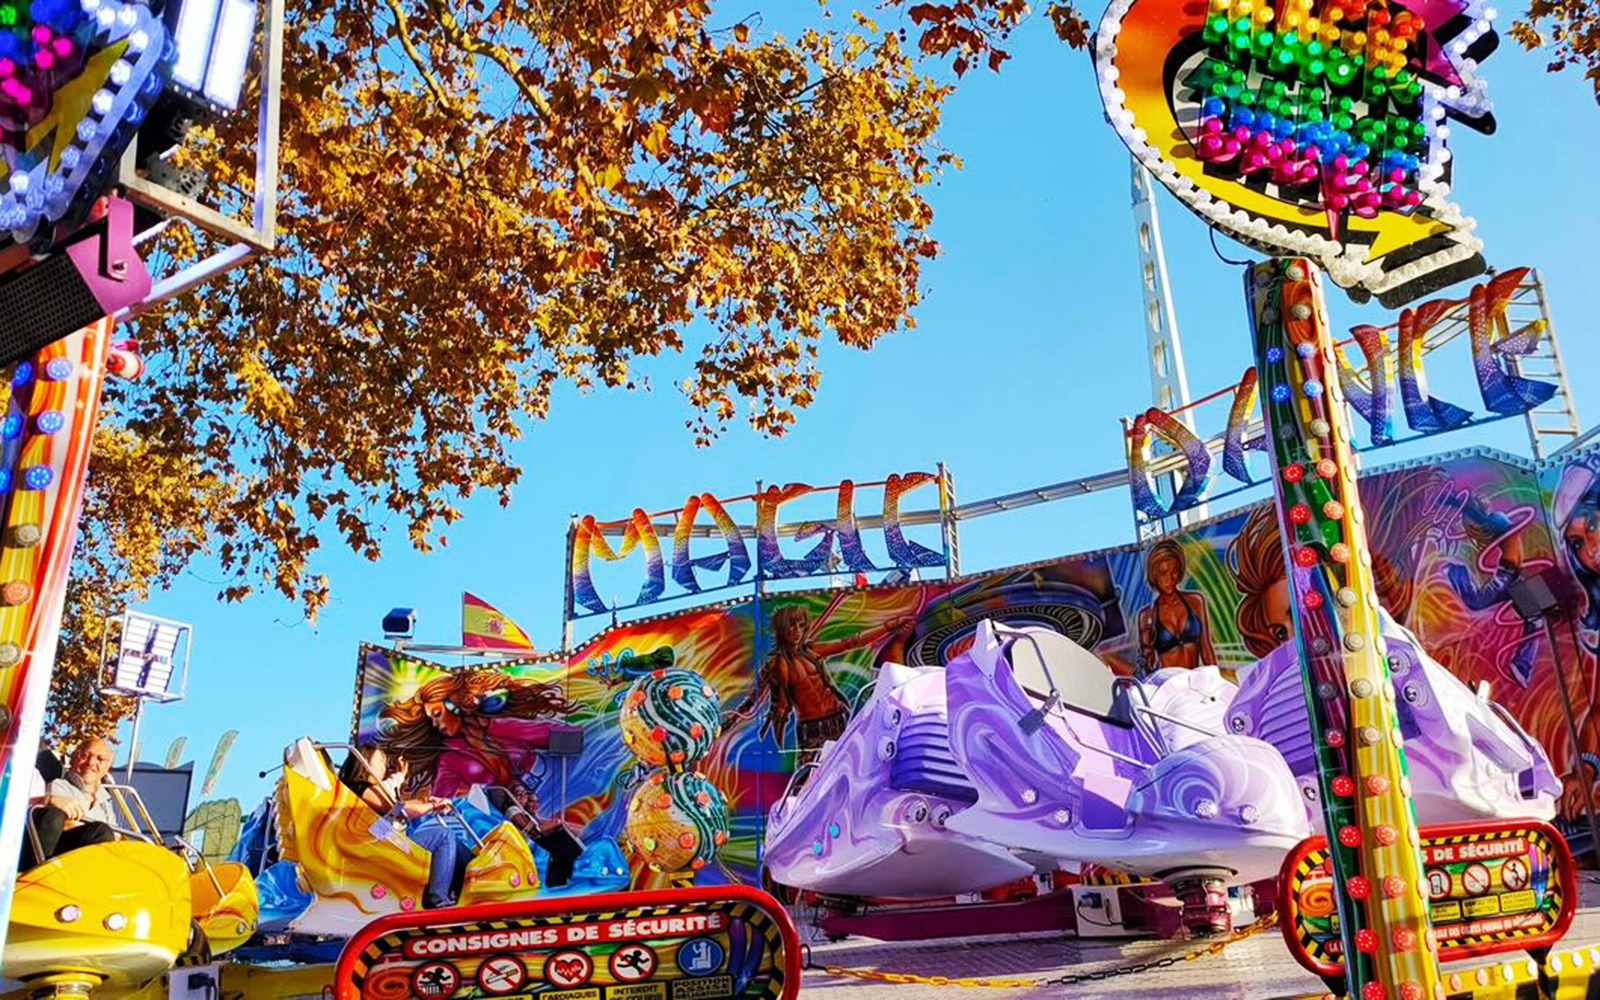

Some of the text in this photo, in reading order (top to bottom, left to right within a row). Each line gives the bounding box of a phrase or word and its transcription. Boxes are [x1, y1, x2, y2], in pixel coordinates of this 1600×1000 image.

[572, 472, 947, 613] MAGIC
[1433, 847, 1454, 861] DE
[1459, 837, 1524, 859] SÉCURITÉ
[412, 912, 721, 954] CONSIGNES DE SÉCURITÉ
[613, 984, 658, 996] INTERDIT
[674, 977, 729, 987] POSITION
[542, 990, 597, 1000] CARDIAQUES
